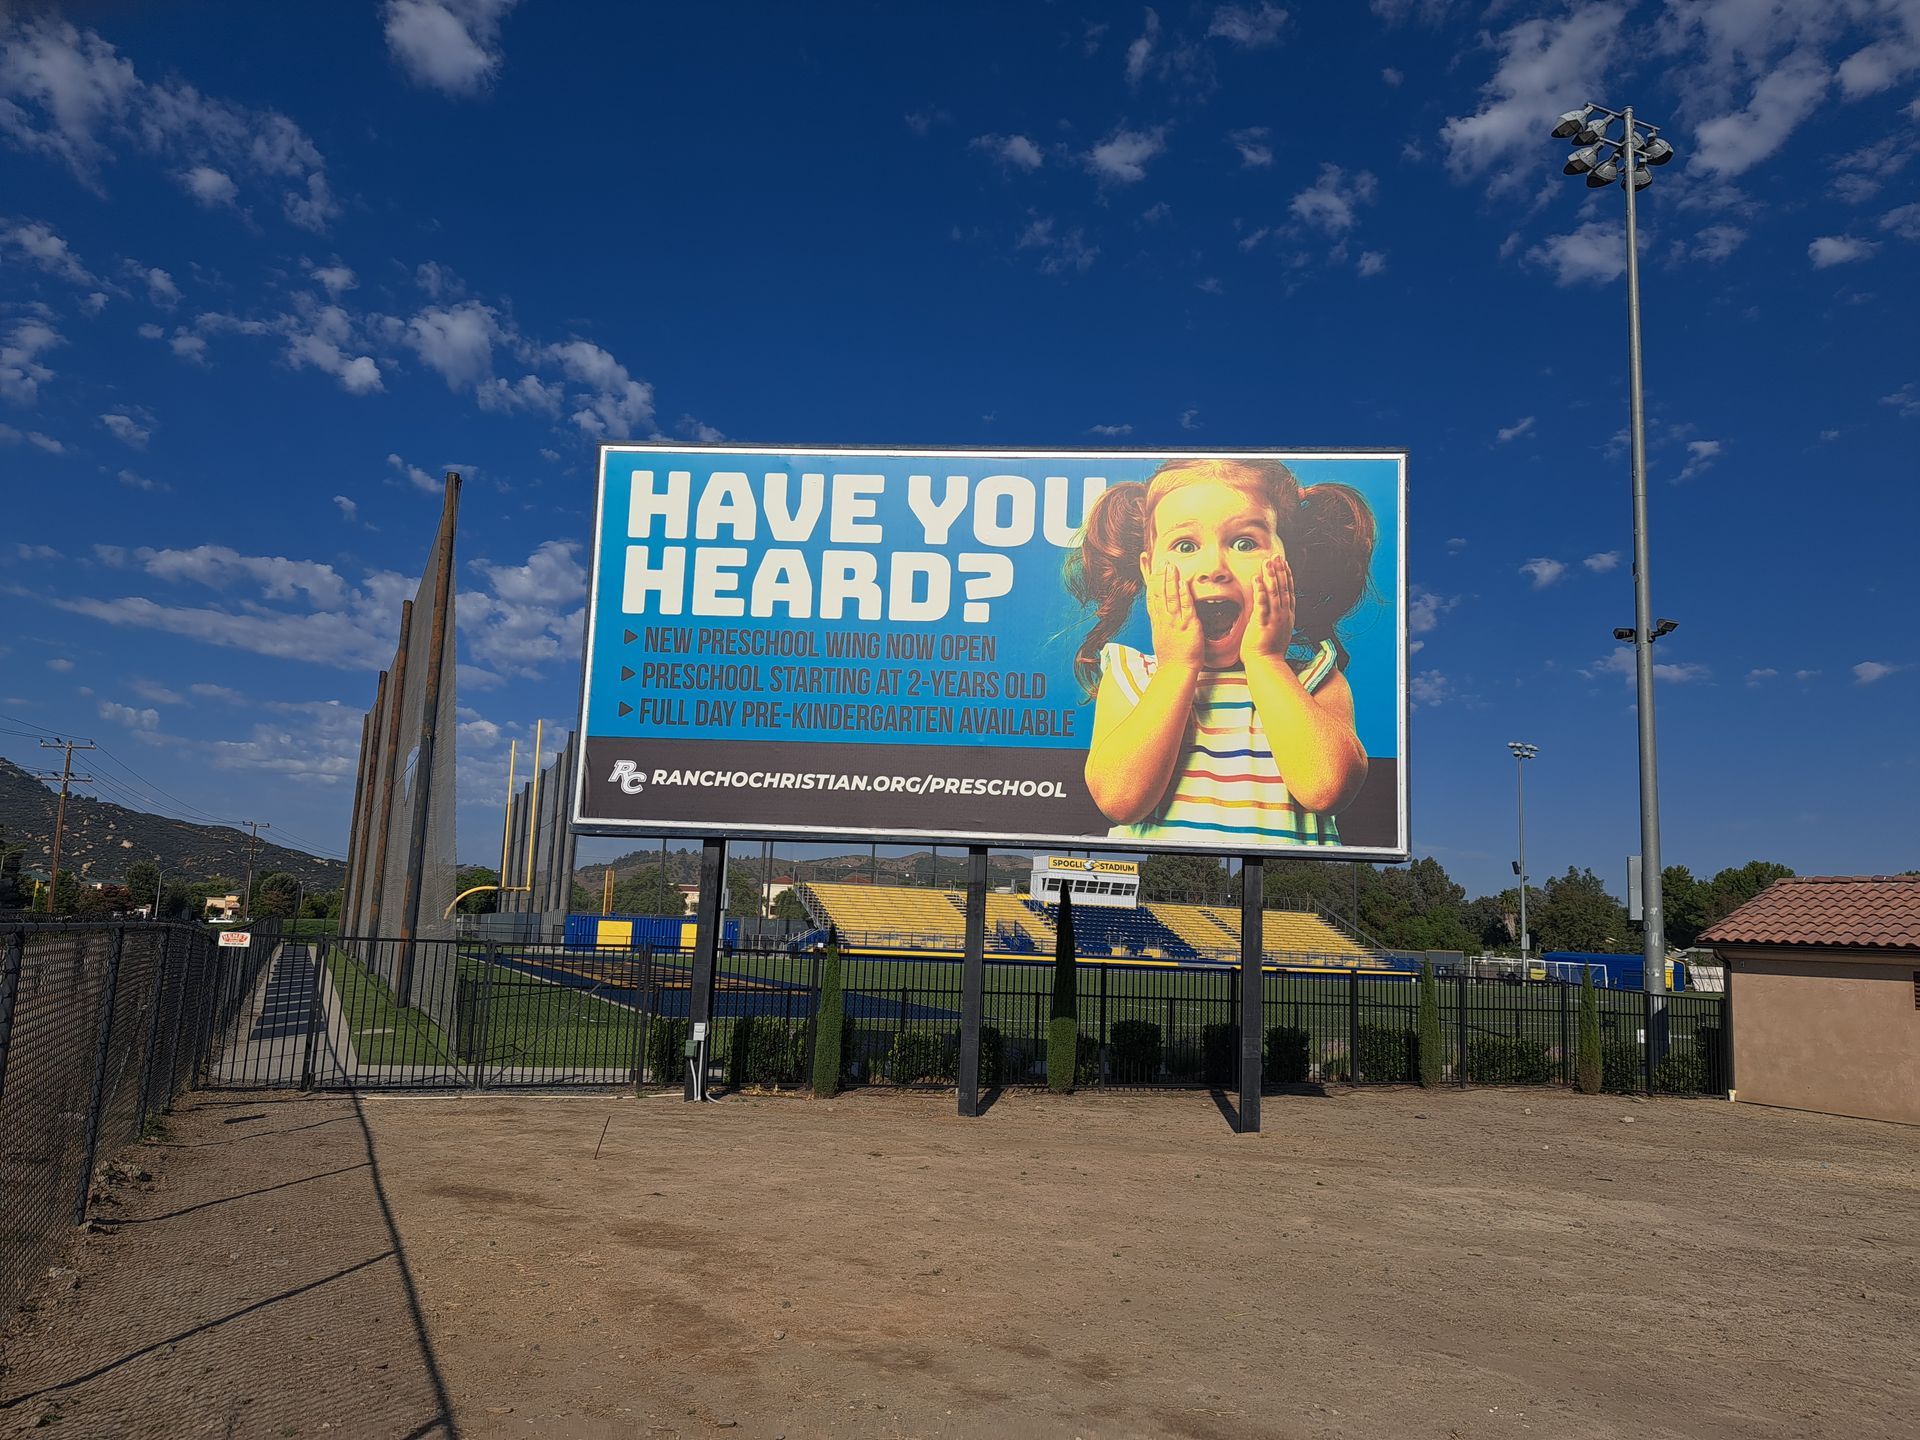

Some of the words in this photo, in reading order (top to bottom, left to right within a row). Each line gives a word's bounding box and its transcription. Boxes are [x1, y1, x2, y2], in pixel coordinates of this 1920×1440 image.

[627, 470, 885, 544] HAVE
[908, 475, 1107, 548] YOU
[621, 545, 1014, 623] HEARD?
[644, 627, 693, 654] NEW
[697, 628, 820, 657] PRESCHOOL
[825, 631, 881, 659] WING
[886, 633, 936, 660] NOW
[940, 634, 997, 662] OPEN
[641, 662, 764, 692] PRESCHOOL
[769, 665, 871, 695] STARTING
[876, 668, 902, 695] AT
[907, 669, 1000, 698] 2-YEARS
[1005, 672, 1046, 699] OLD
[639, 698, 689, 725] FULL
[694, 700, 737, 727] DAY
[741, 701, 954, 734] PRE-KINDERGARTEN
[959, 707, 1076, 737] AVAILABLE
[608, 760, 648, 795] RC
[651, 769, 1067, 799] RANCHOCHRISTIAN.ORG/PRESCHOOL
[1053, 859, 1082, 868] SPOGLI
[1099, 863, 1135, 872] STADIUM
